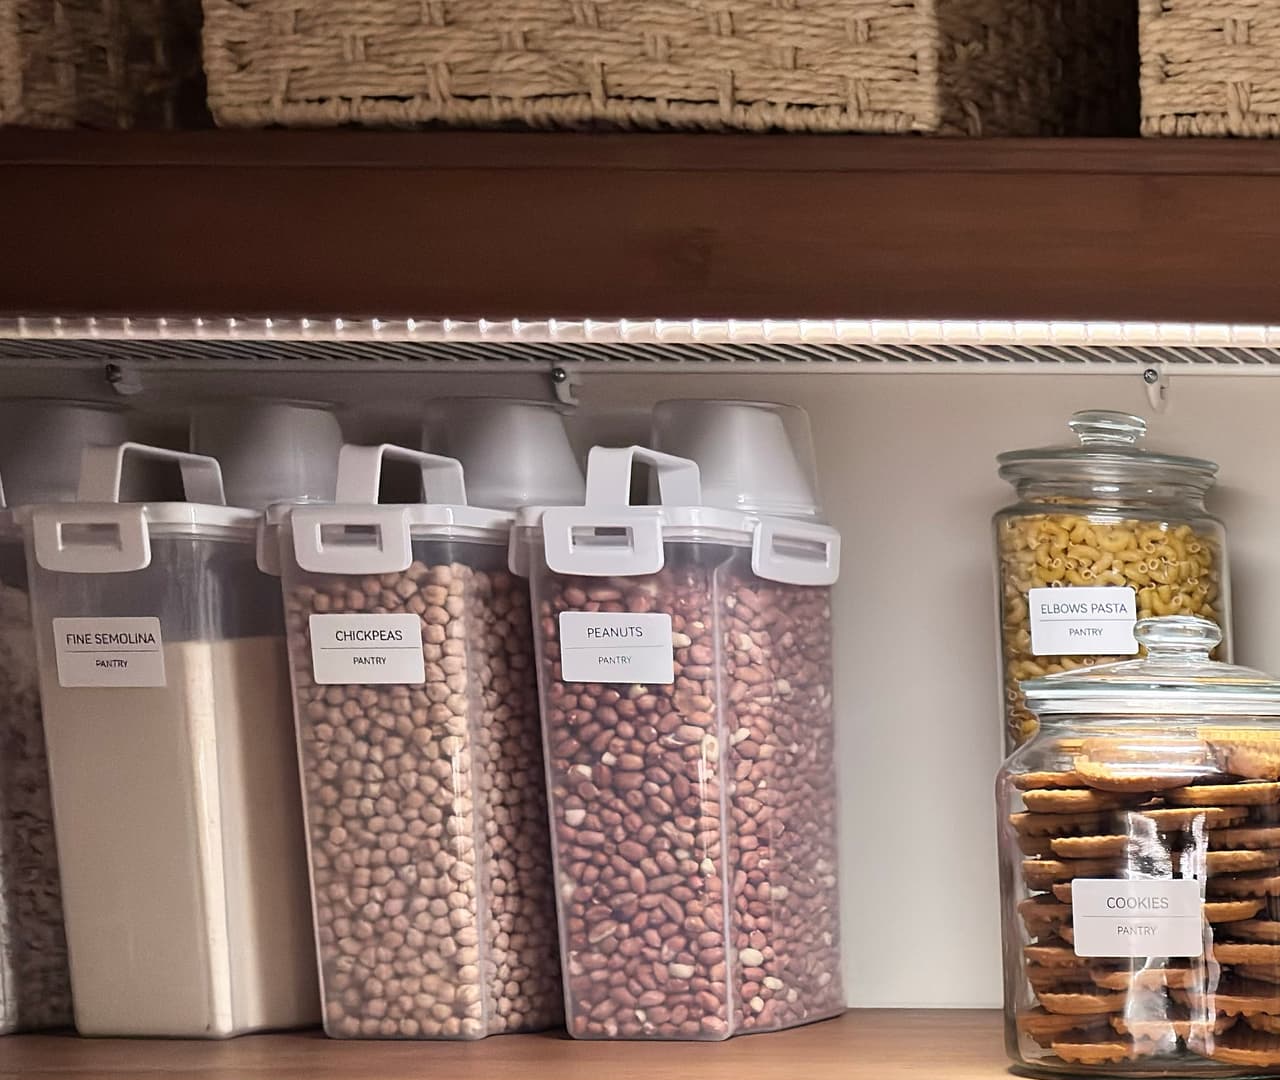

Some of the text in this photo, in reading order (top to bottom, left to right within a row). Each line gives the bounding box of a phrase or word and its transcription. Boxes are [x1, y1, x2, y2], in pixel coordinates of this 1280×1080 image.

[1040, 603, 1129, 616] ELBOWS PASTA
[335, 630, 403, 641] CHICKPEAS
[586, 626, 643, 638] PEANUTS
[1069, 628, 1104, 637] PANTRY
[65, 632, 156, 645] FINE SEMOLINA
[95, 659, 129, 669] PANTRY
[352, 656, 387, 666] PANTRY
[598, 655, 632, 665] PANTRY
[1106, 897, 1169, 909] COOKIES
[1116, 926, 1158, 936] PANTRY
